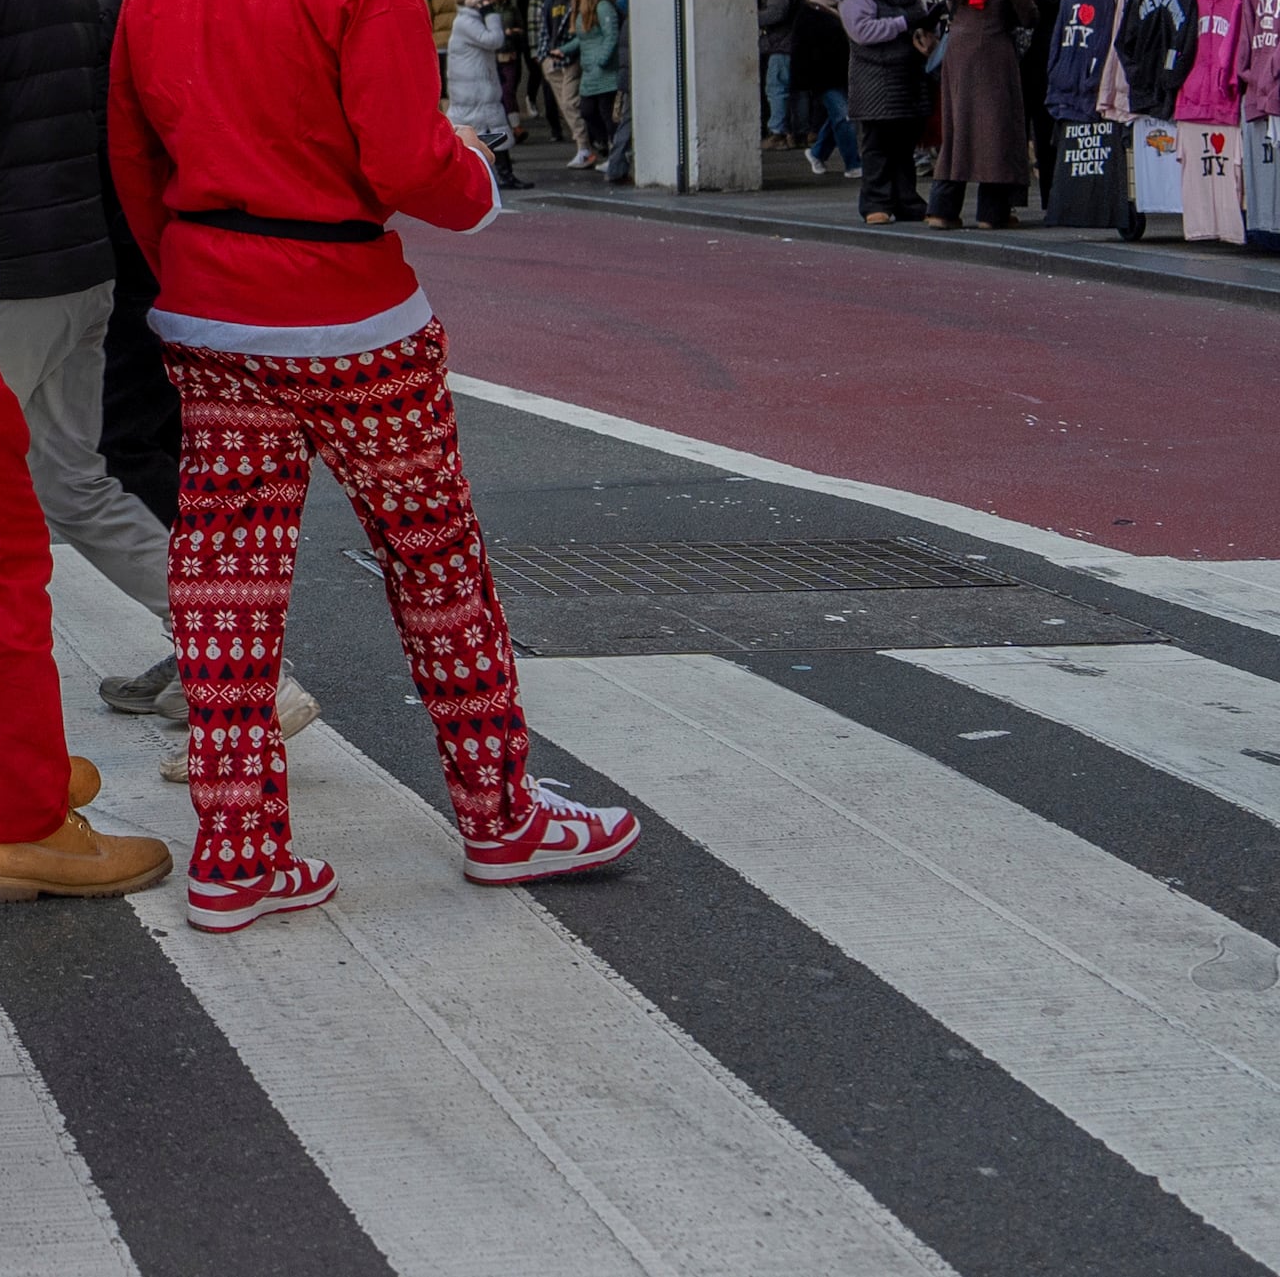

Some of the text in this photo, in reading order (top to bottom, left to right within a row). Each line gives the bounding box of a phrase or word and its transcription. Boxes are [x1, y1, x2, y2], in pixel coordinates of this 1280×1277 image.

[1069, 3, 1081, 25] I
[1061, 26, 1095, 49] NY
[1065, 122, 1113, 139] FUCK YOU
[1077, 135, 1101, 149] YOU
[1201, 132, 1210, 154] I
[1064, 147, 1112, 164] FUCKIN'
[1071, 160, 1105, 177] FUCK
[1200, 156, 1229, 177] NY
